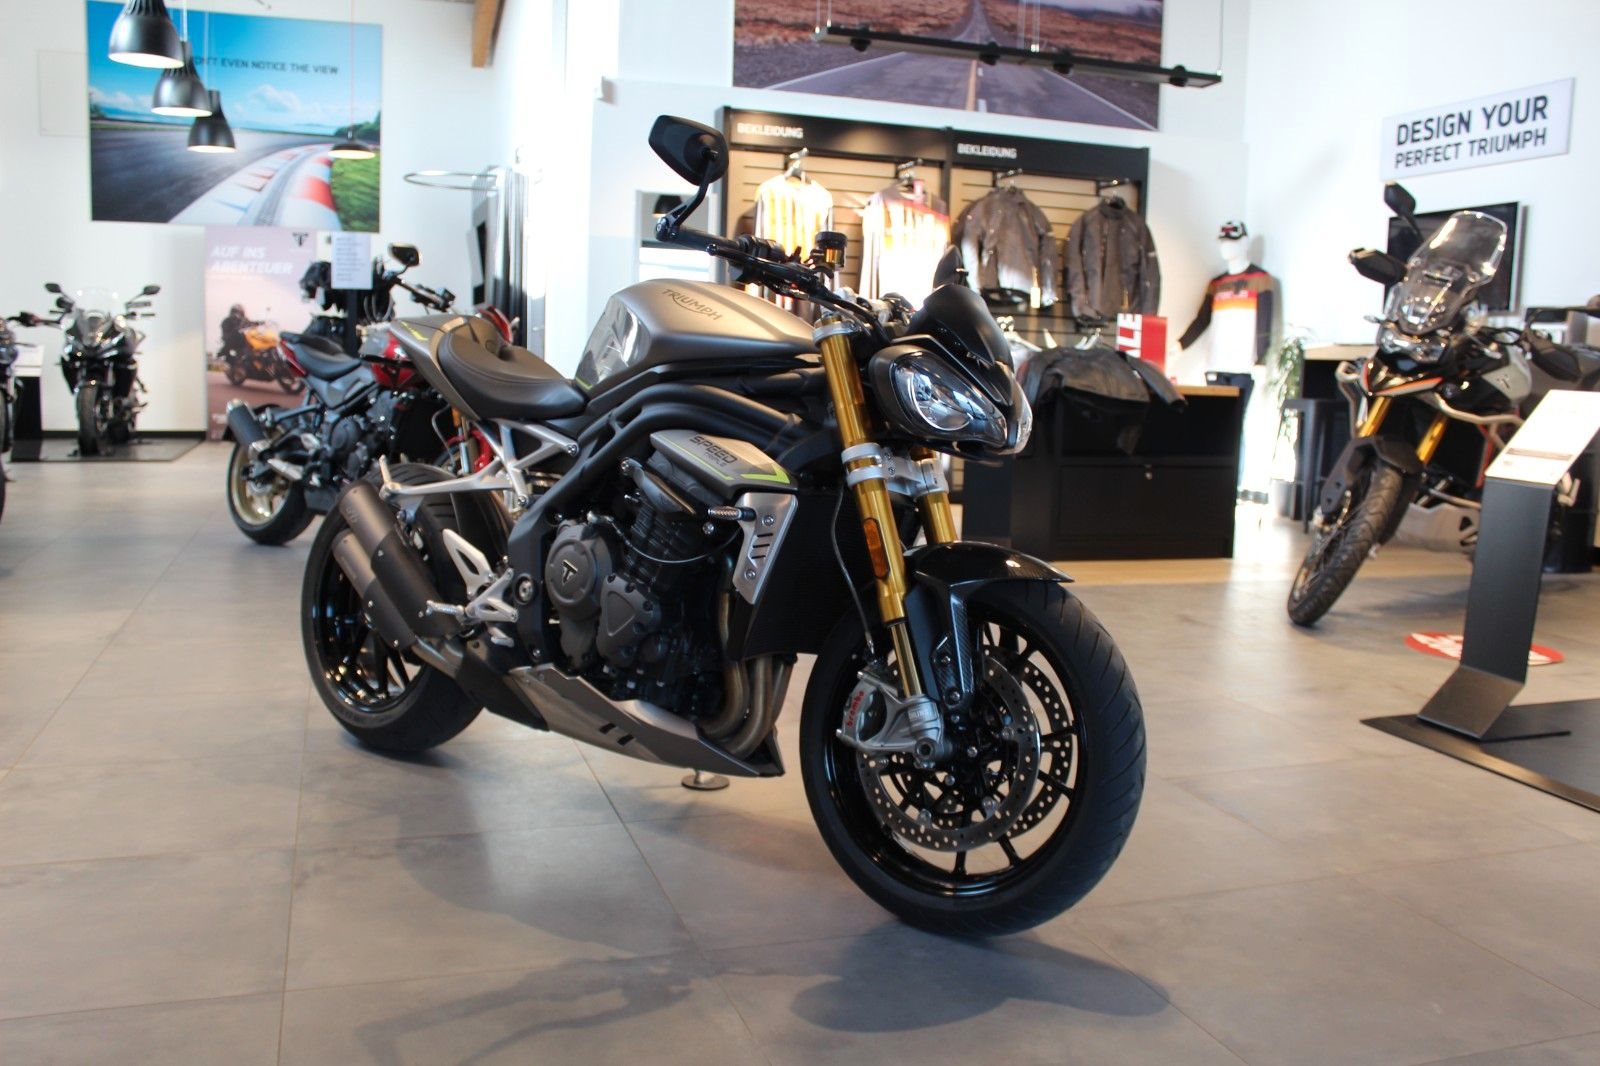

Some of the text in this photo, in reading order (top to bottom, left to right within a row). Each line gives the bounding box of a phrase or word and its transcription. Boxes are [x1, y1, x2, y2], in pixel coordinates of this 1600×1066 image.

[220, 58, 249, 69] EVEN
[251, 60, 287, 72] NOTICE
[290, 62, 310, 73] THE
[312, 65, 339, 75] VIEW
[736, 122, 804, 139] BEKLEIDUNG
[1396, 95, 1549, 147] DESIGN YOUR
[956, 143, 1017, 159] BEKLEIDUNG
[1394, 127, 1548, 169] PERFECT TRIUMPH
[661, 288, 723, 321] TRIUMPH
[688, 436, 738, 464] SPEED
